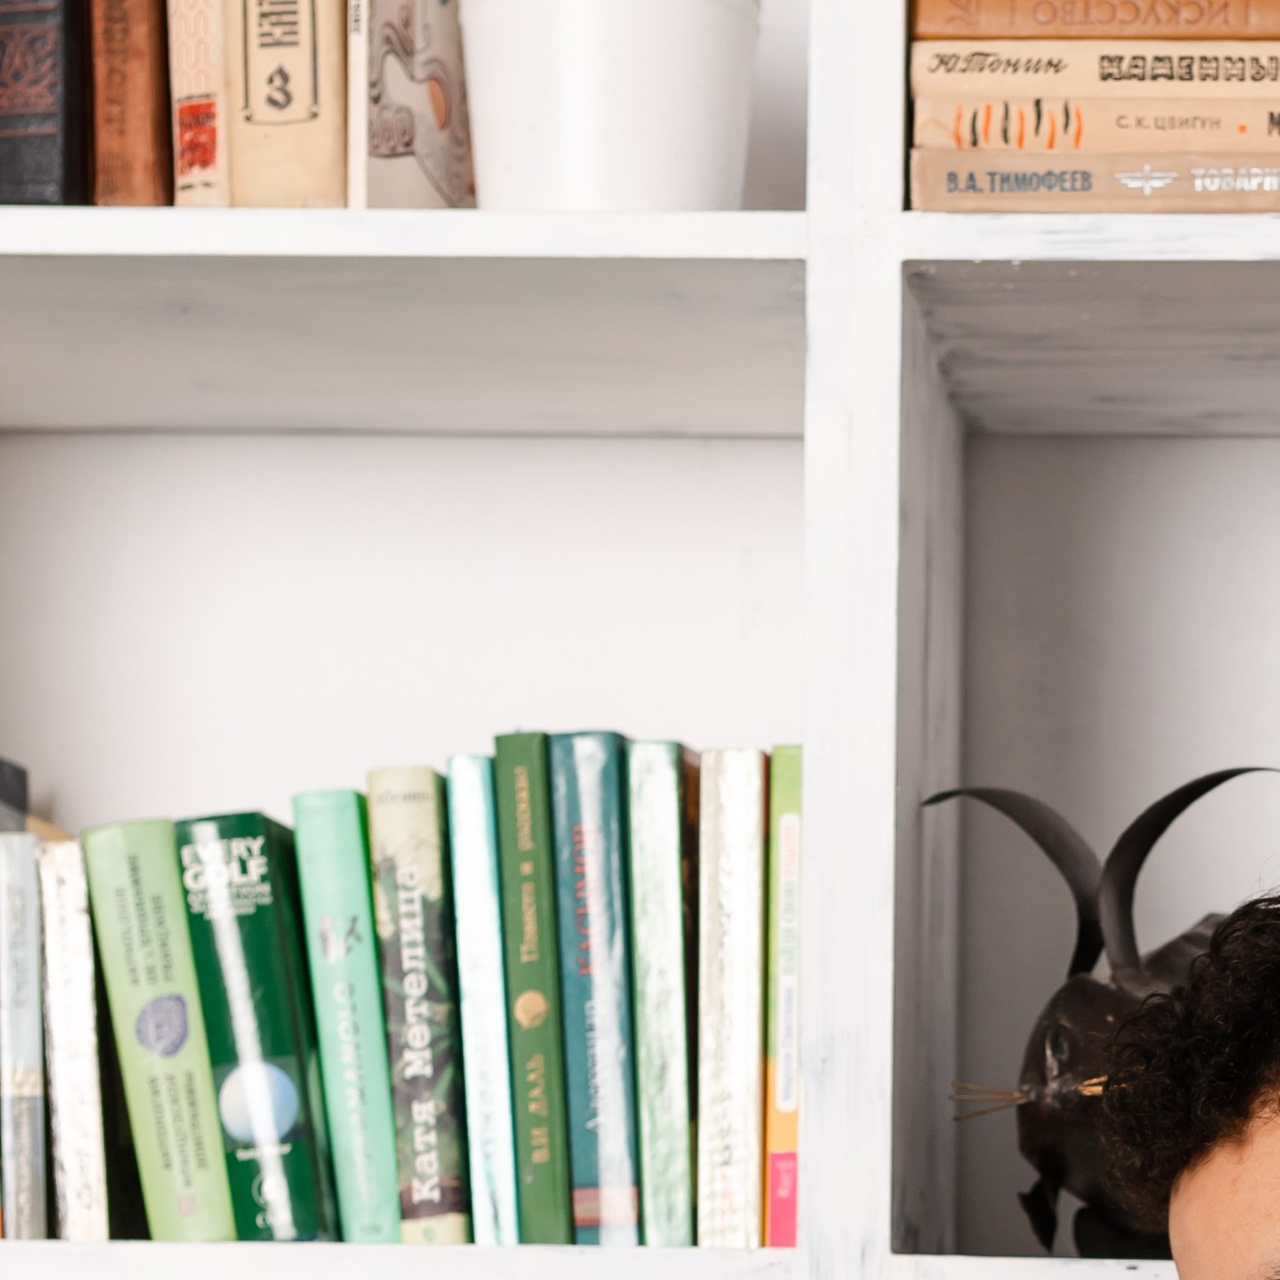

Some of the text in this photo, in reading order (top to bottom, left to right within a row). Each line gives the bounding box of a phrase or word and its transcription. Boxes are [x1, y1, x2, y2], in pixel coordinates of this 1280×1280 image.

[987, 170, 1094, 192] ТИМОФЕЕВ
[396, 863, 442, 1205] Катя Метелица
